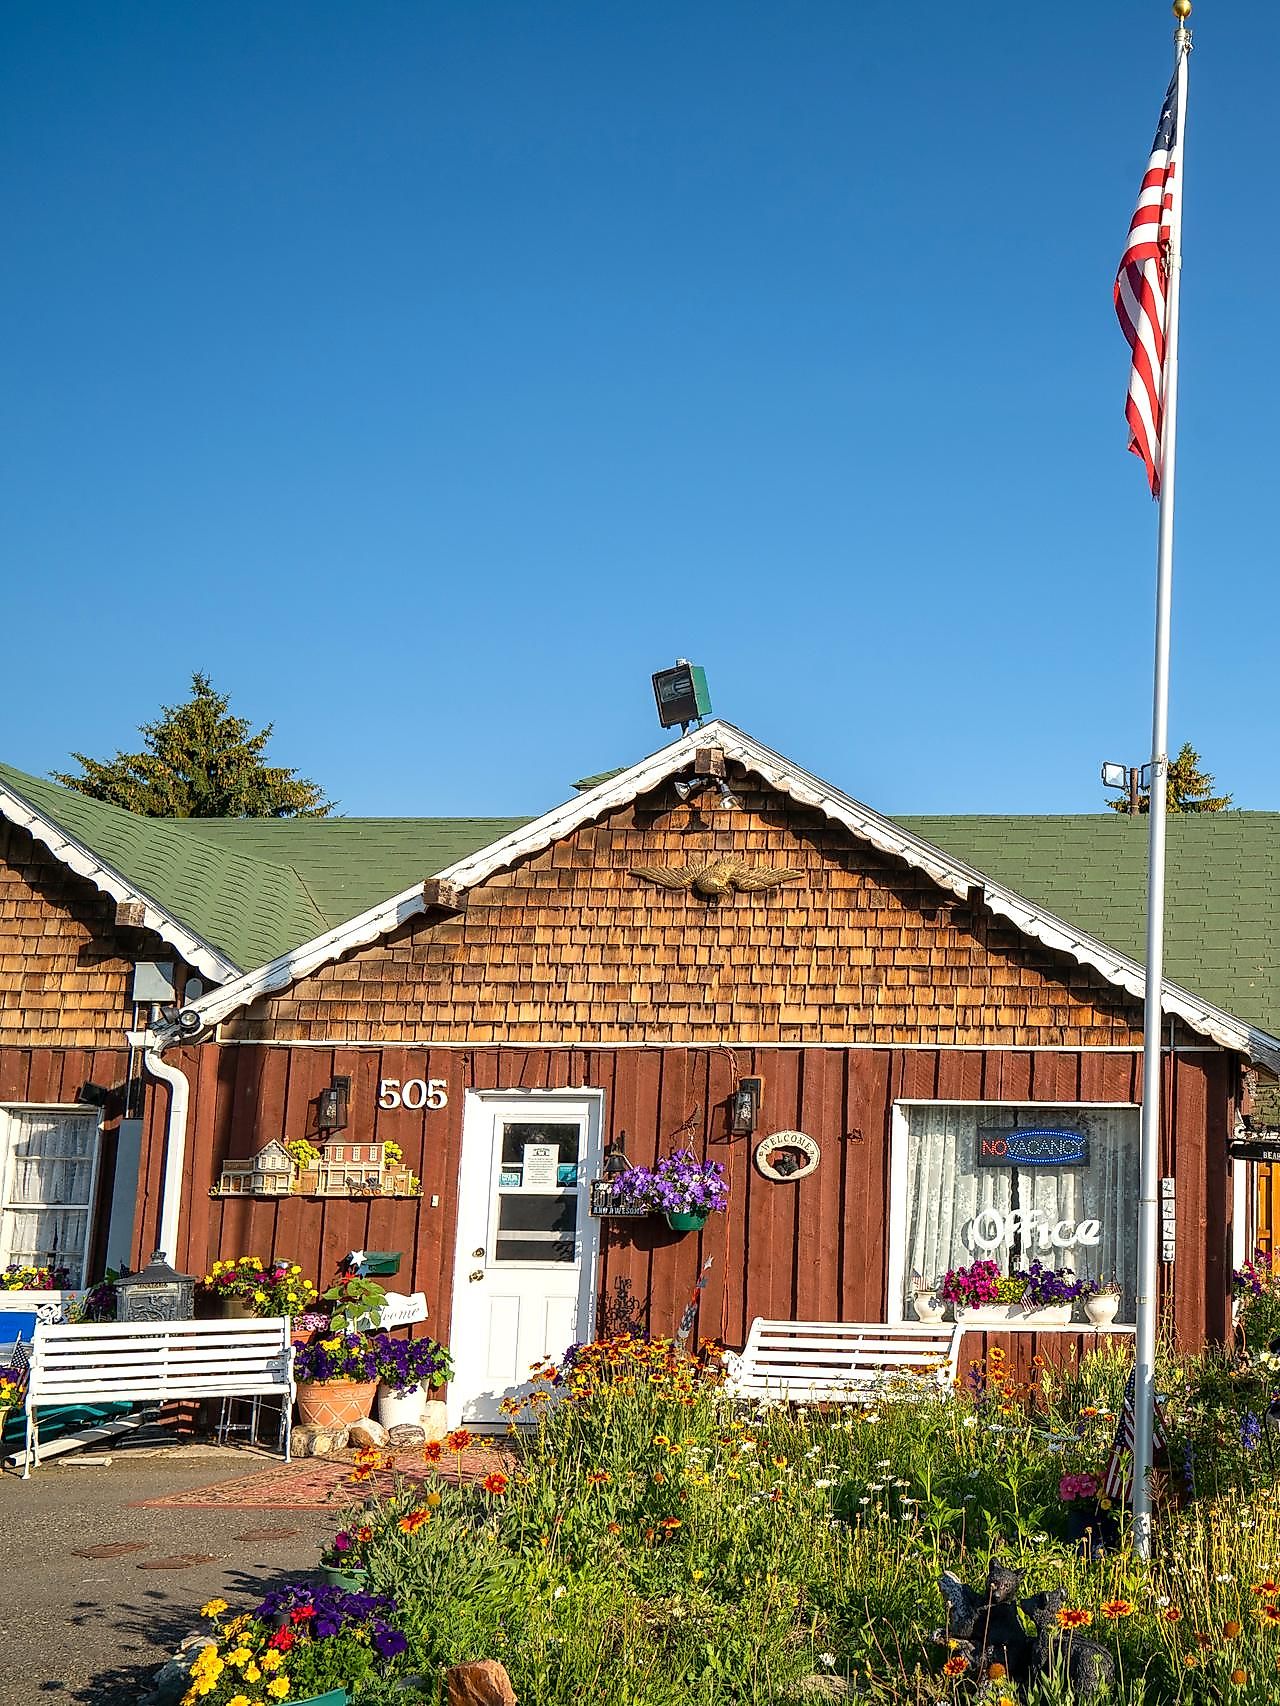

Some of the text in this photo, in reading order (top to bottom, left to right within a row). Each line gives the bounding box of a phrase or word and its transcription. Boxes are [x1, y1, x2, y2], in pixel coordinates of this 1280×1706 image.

[378, 1078, 449, 1110] 505
[760, 1133, 812, 1151] WELCOME
[982, 1139, 1086, 1156] NO VACANCY
[966, 1208, 1101, 1251] Office
